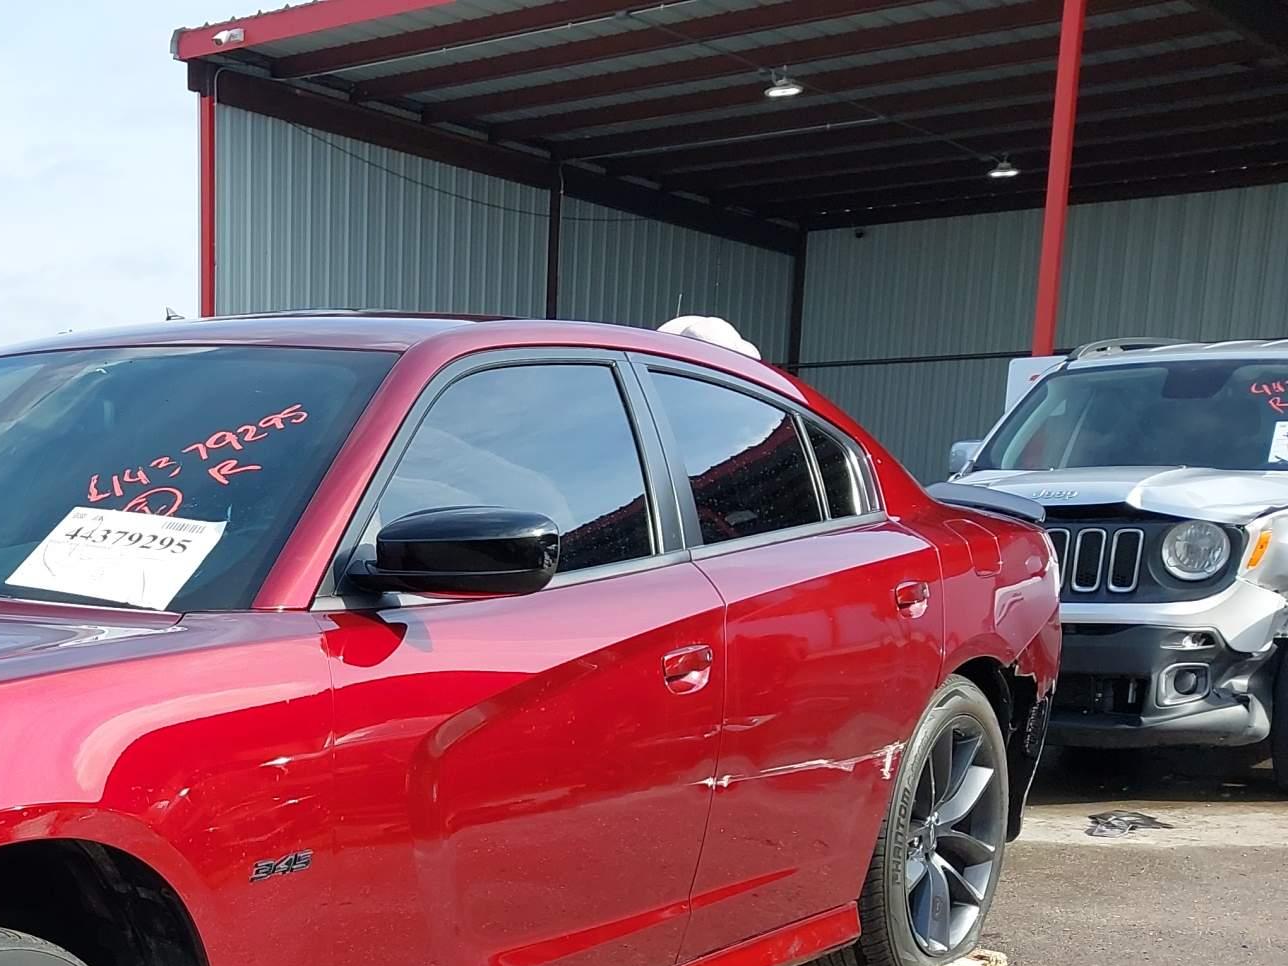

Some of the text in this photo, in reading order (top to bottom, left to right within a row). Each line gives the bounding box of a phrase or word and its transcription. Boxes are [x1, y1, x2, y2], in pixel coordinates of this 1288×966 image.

[208, 459, 262, 486] R
[1031, 488, 1079, 500] Jeep
[64, 525, 193, 554] 44379295
[249, 848, 314, 882] 345
